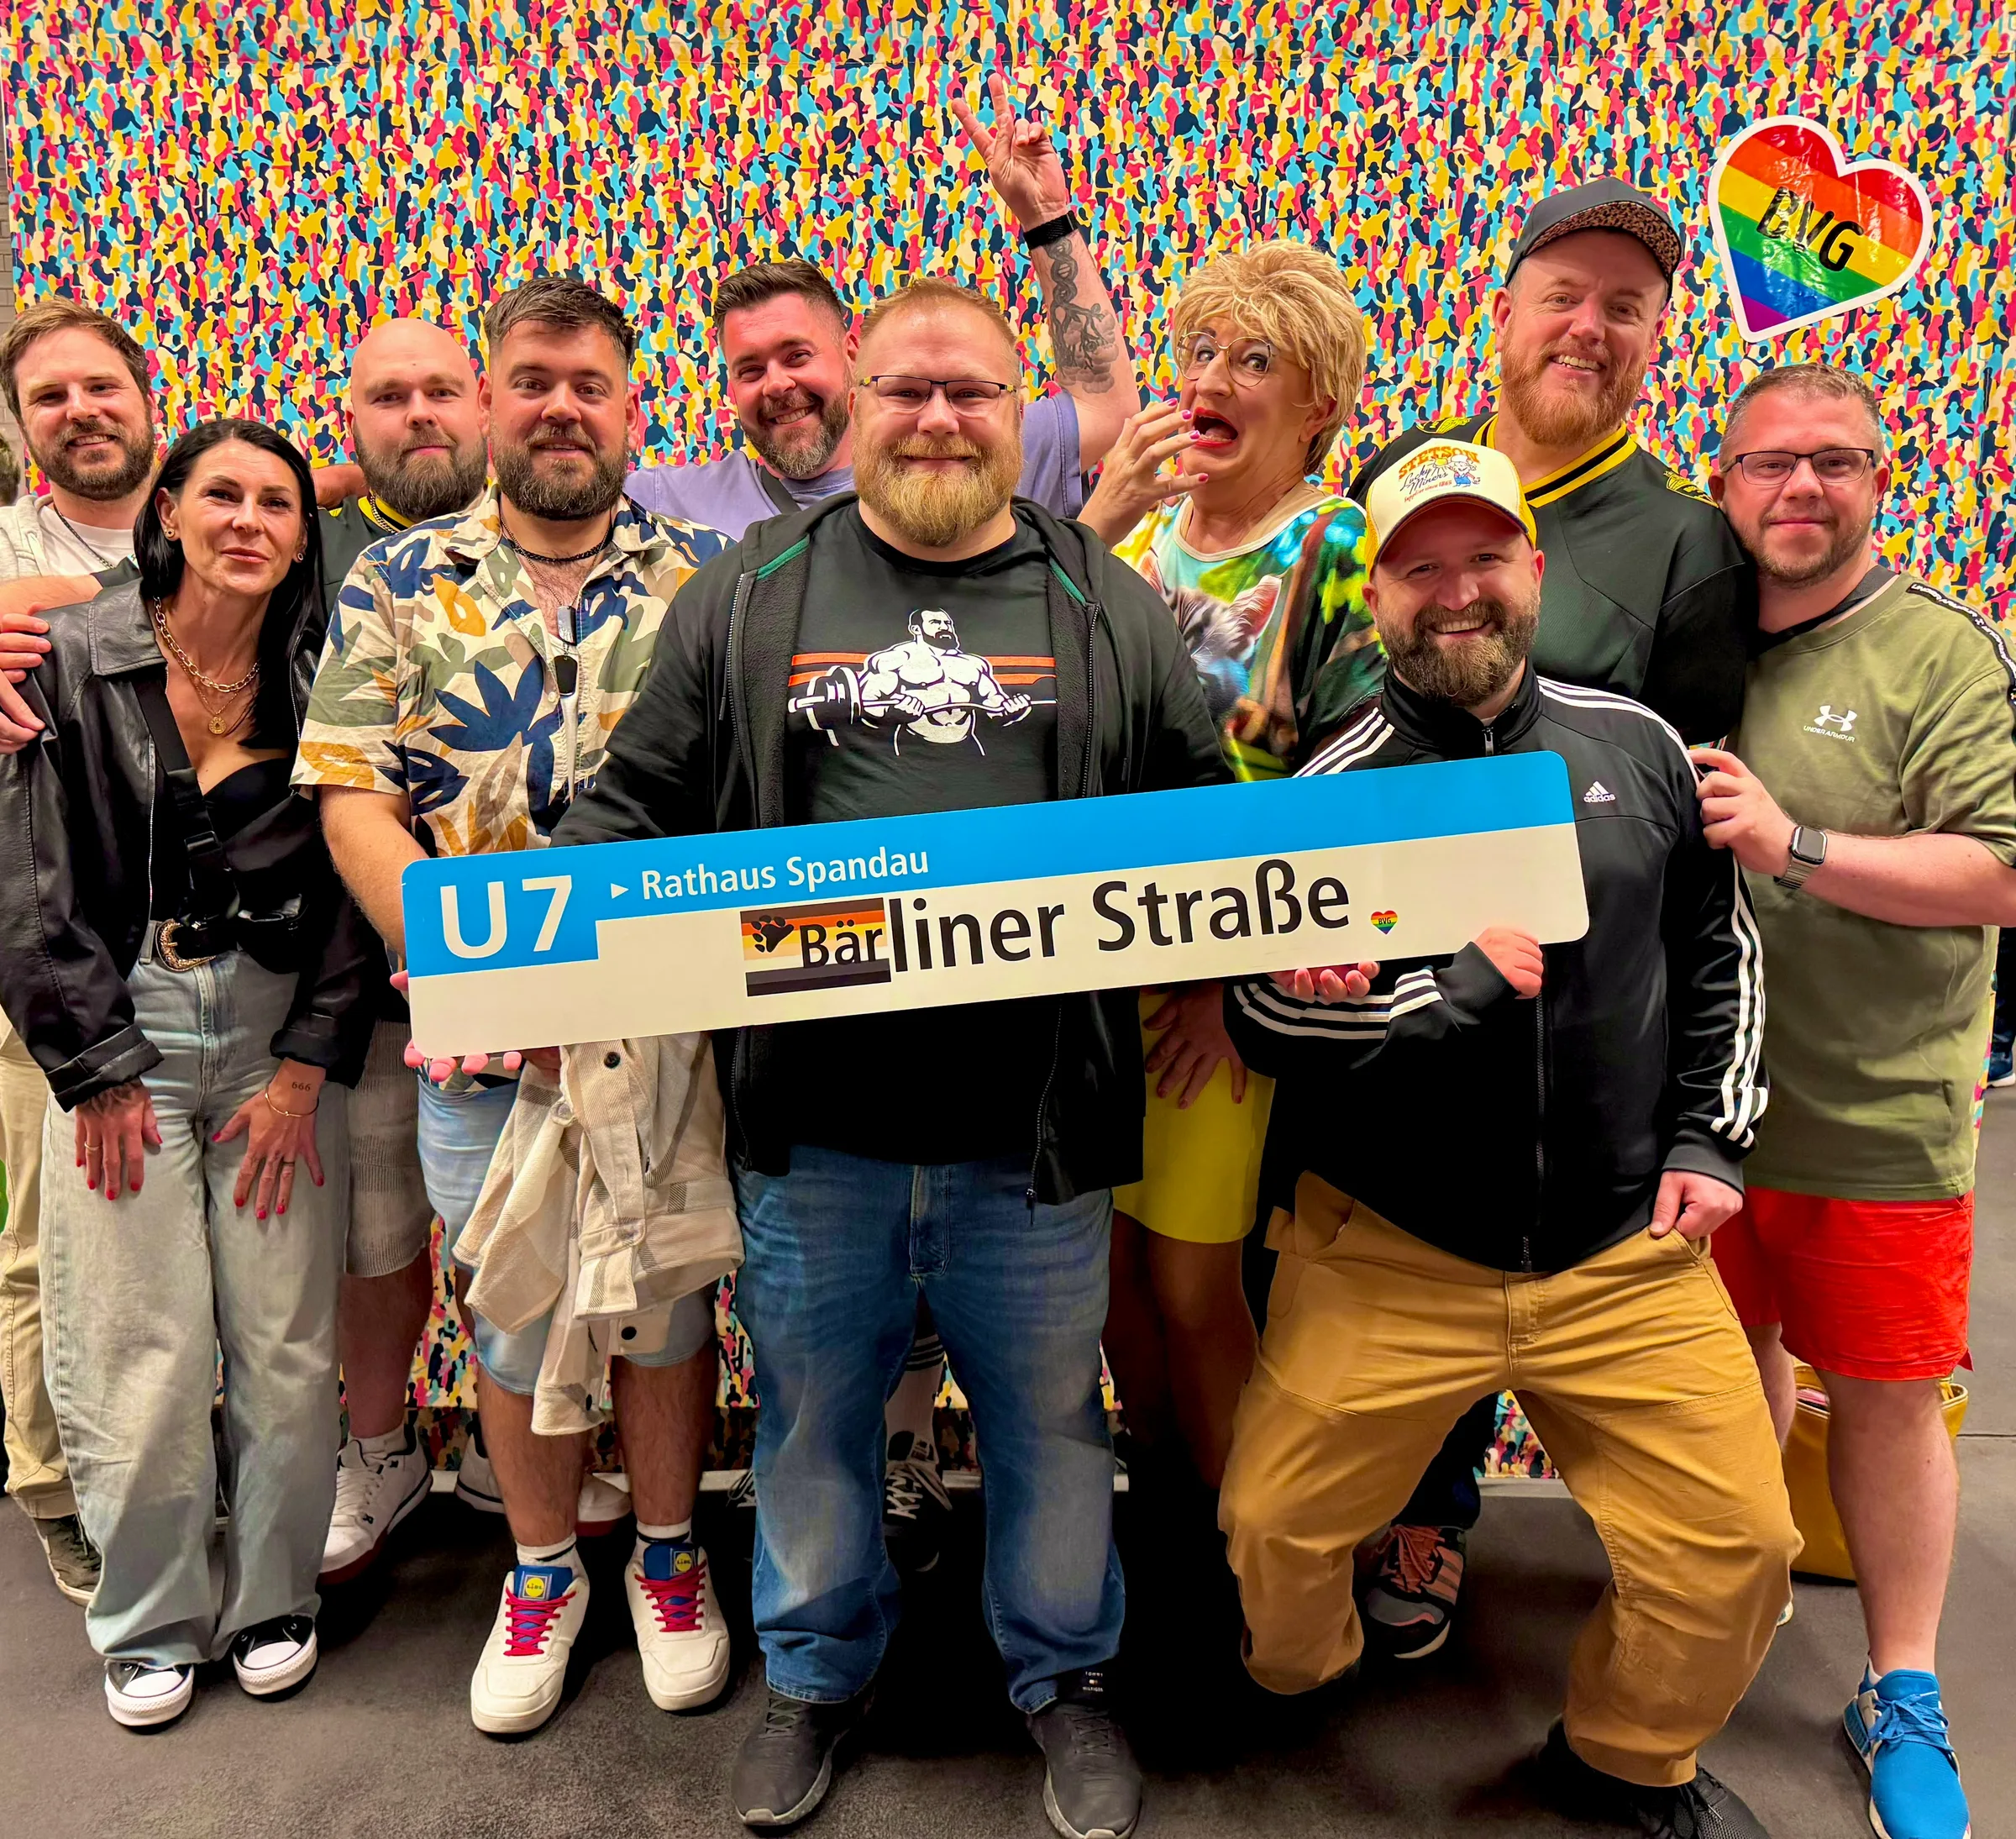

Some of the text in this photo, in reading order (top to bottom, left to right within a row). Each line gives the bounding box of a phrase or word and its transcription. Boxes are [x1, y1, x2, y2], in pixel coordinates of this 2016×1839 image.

[1756, 186, 1865, 272] BVG
[1399, 446, 1480, 480] STETSON
[1399, 465, 1431, 491] Lucky
[1803, 725, 1856, 743] UNDER ARMOUR
[1583, 794, 1616, 803] adidas
[642, 847, 928, 900] Rathaus Spandau
[1093, 859, 1349, 951] Straße
[1378, 917, 1392, 925] BVG
[291, 1081, 312, 1091] 666
